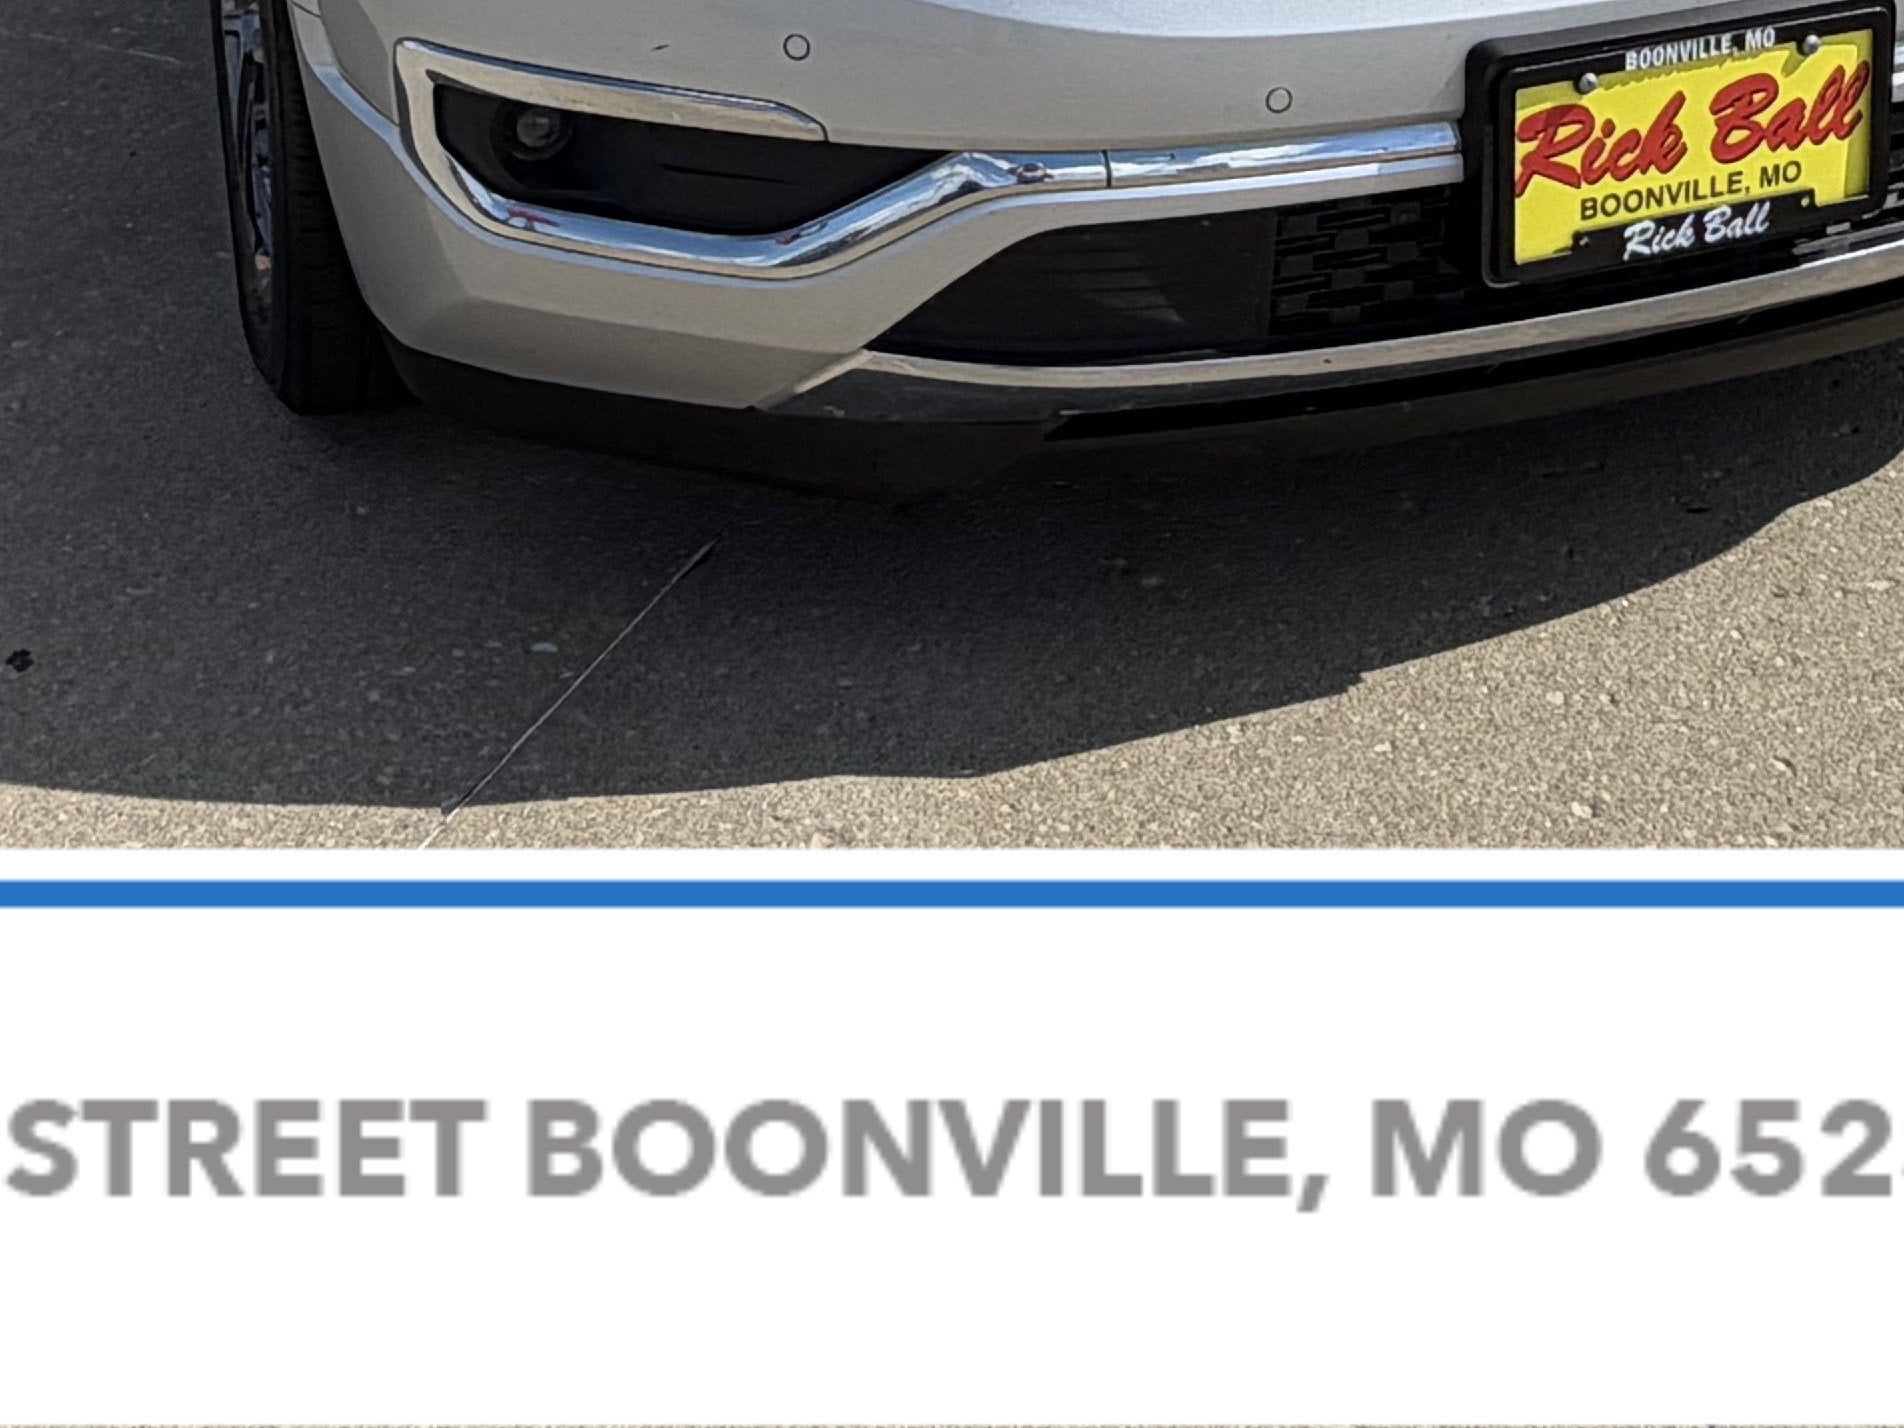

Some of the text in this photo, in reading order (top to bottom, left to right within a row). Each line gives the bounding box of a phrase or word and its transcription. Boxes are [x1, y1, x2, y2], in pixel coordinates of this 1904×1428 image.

[1625, 25, 1776, 71] BOONVILLE, MO
[1515, 60, 1870, 197] Rick Ball
[1579, 160, 1803, 221] BOONVILLE, MO
[1622, 202, 1771, 262] Rick Ball
